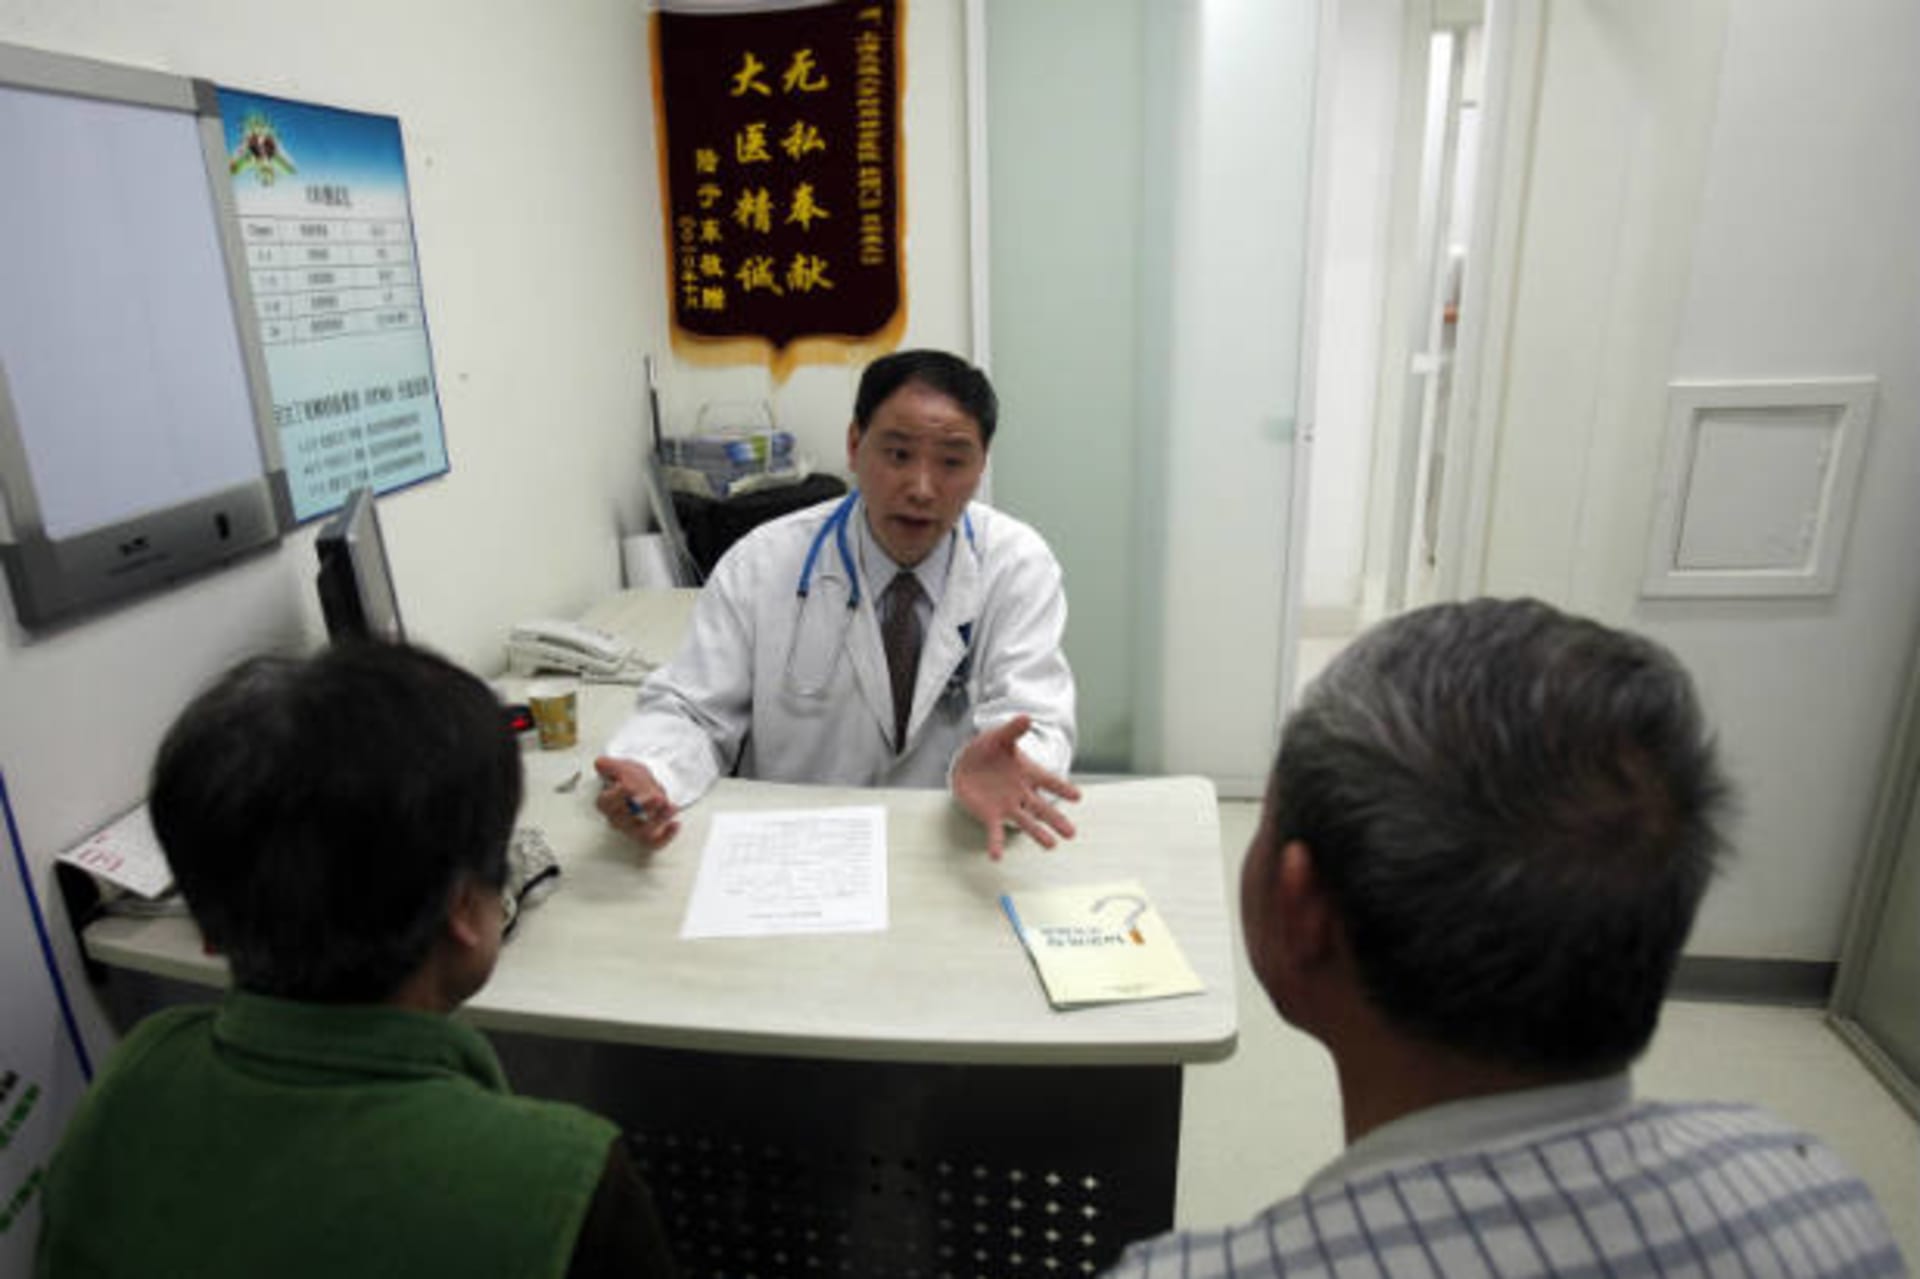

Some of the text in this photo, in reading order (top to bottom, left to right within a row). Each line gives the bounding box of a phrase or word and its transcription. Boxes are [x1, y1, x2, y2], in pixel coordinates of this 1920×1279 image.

[730, 50, 784, 298] 大医精诚
[780, 48, 835, 293] 无私奉献
